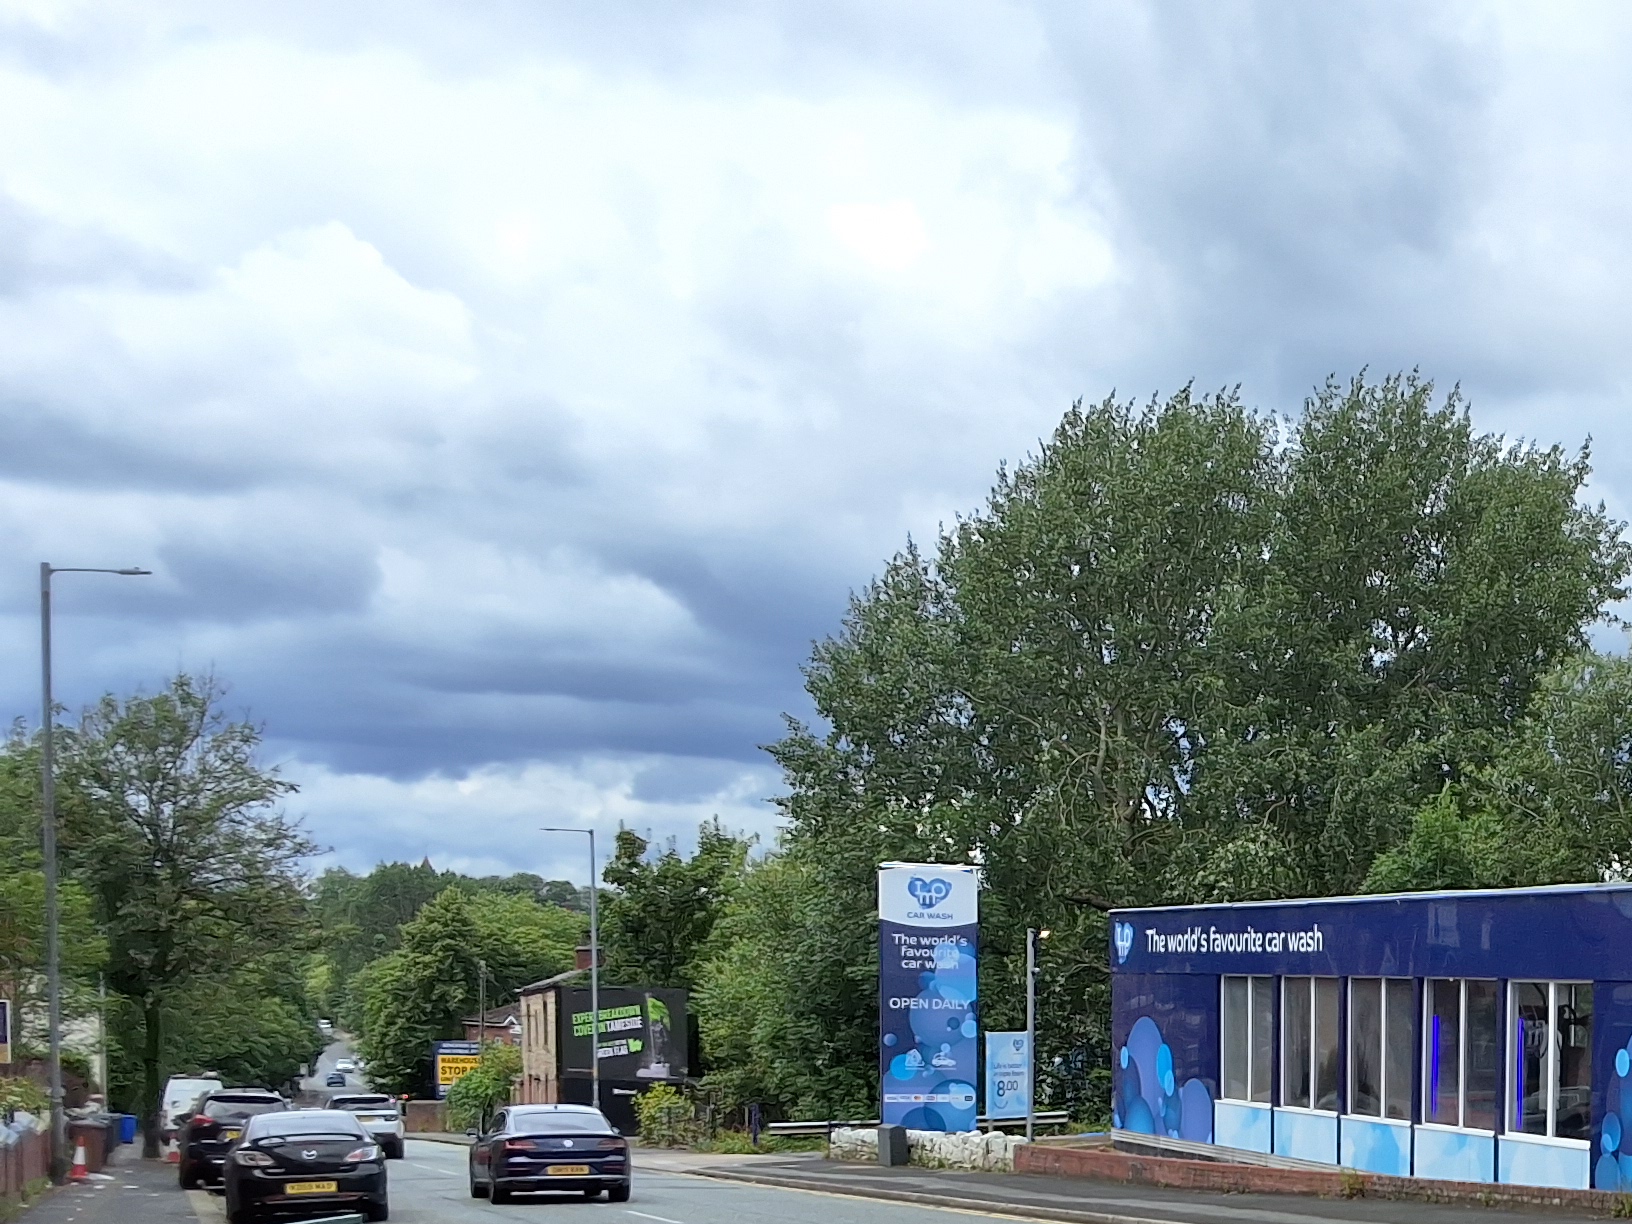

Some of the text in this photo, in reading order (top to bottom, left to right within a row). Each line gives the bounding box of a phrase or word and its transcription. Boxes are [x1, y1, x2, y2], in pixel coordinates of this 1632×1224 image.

[906, 911, 954, 920] CAR WASH
[891, 933, 968, 947] The world's
[1145, 923, 1324, 952] The world's favourite car wash
[901, 945, 959, 957] favourite
[901, 959, 959, 970] car wash
[889, 997, 969, 1010] OPEN DAILY
[440, 1066, 468, 1076] STOP
